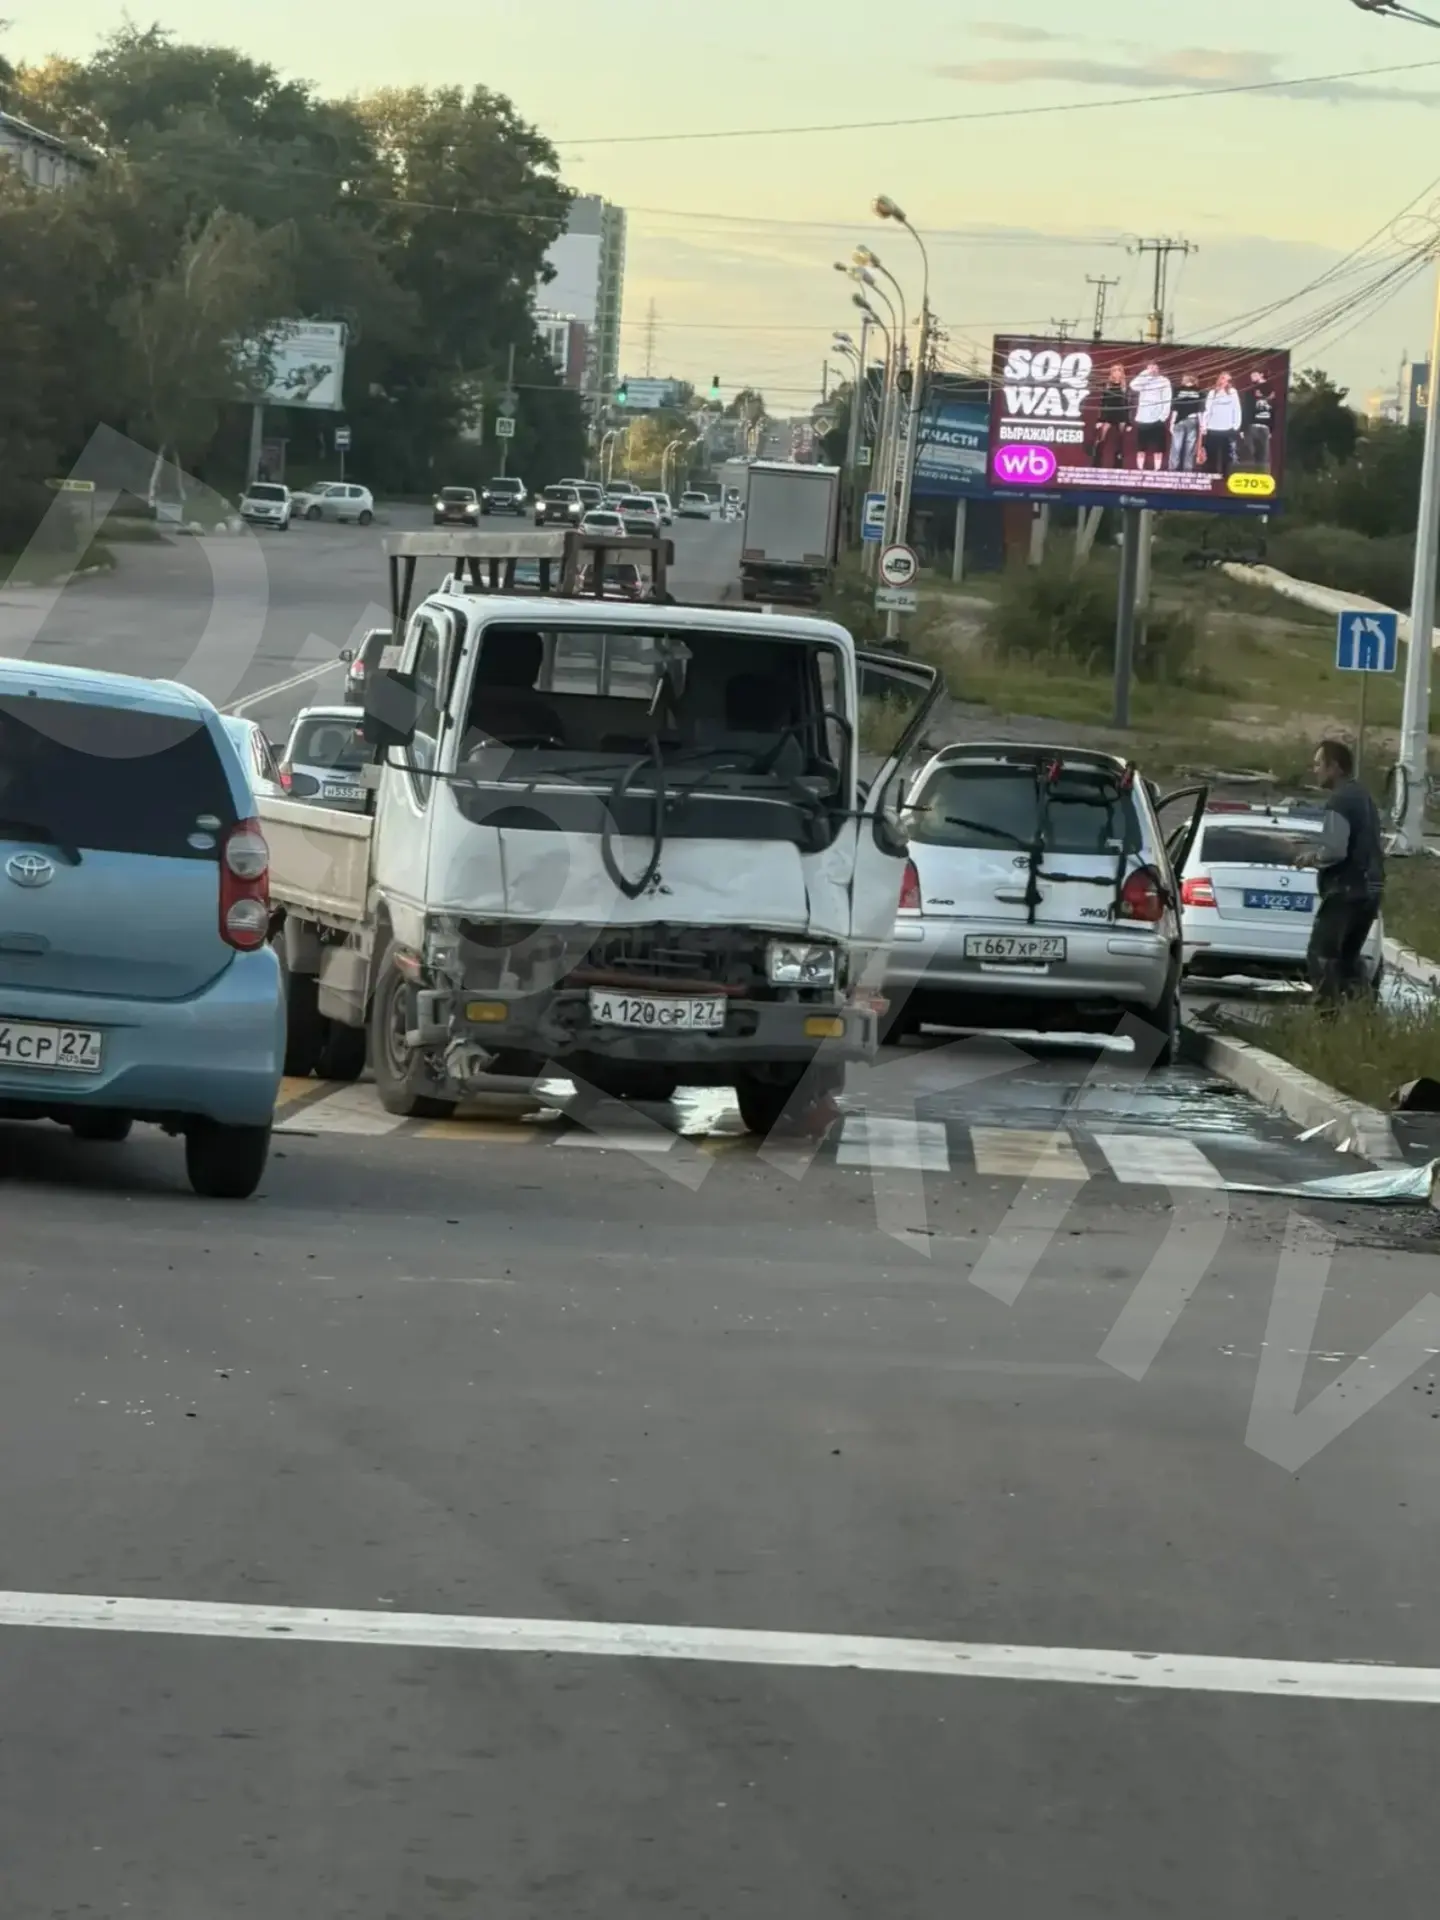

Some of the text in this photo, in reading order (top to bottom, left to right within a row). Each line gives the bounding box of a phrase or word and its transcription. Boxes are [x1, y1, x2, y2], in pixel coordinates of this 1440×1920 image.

[1004, 349, 1092, 388] SOQ
[1003, 387, 1089, 416] WAY
[1000, 425, 1084, 443] ВЫРАЖАЙ СЕБЯ
[1002, 449, 1049, 476] wb
[1042, 939, 1059, 952] 27
[694, 1001, 717, 1020] 27
[62, 1032, 92, 1055] 27
